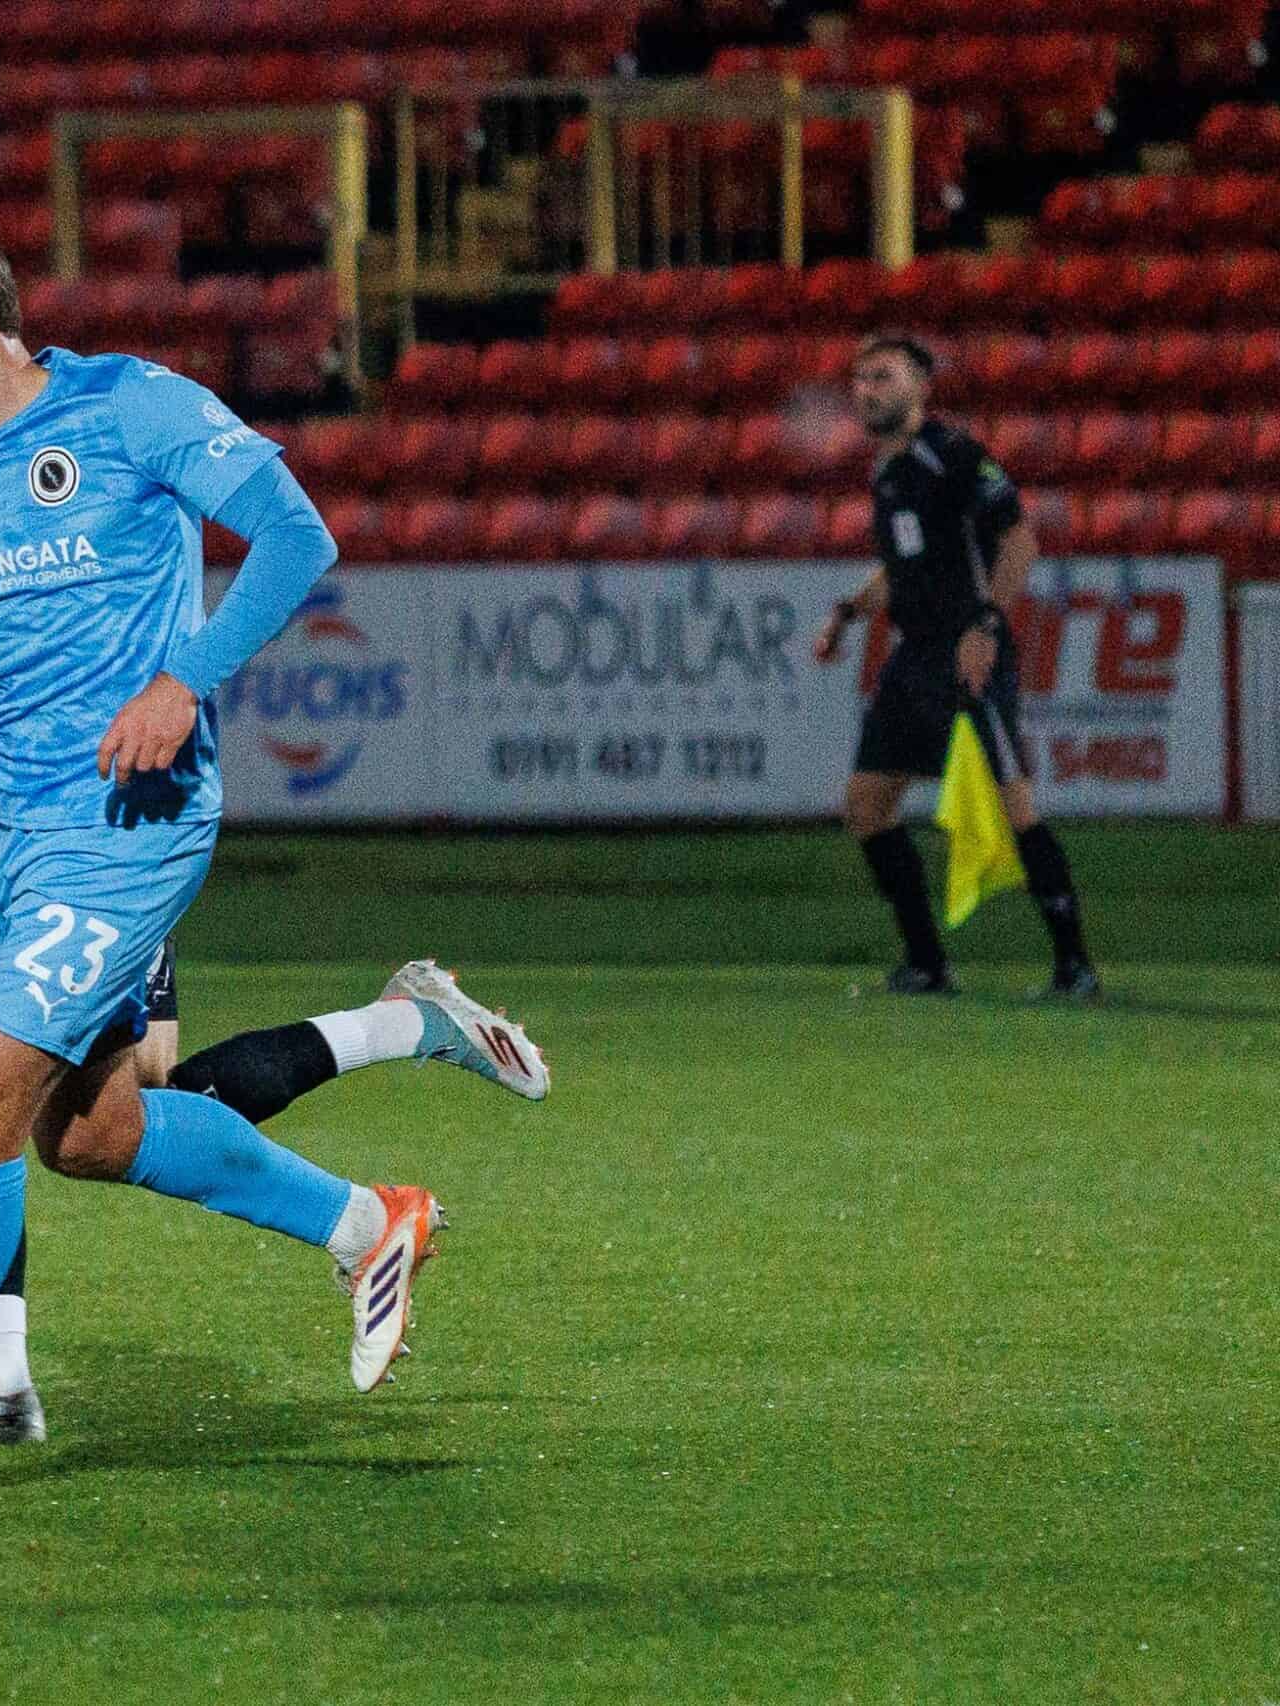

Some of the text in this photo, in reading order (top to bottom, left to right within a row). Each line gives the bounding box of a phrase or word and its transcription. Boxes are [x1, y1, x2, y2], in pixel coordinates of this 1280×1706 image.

[451, 597, 796, 684] MODULAR
[222, 661, 408, 721] FUCHS
[14, 903, 119, 994] 23
